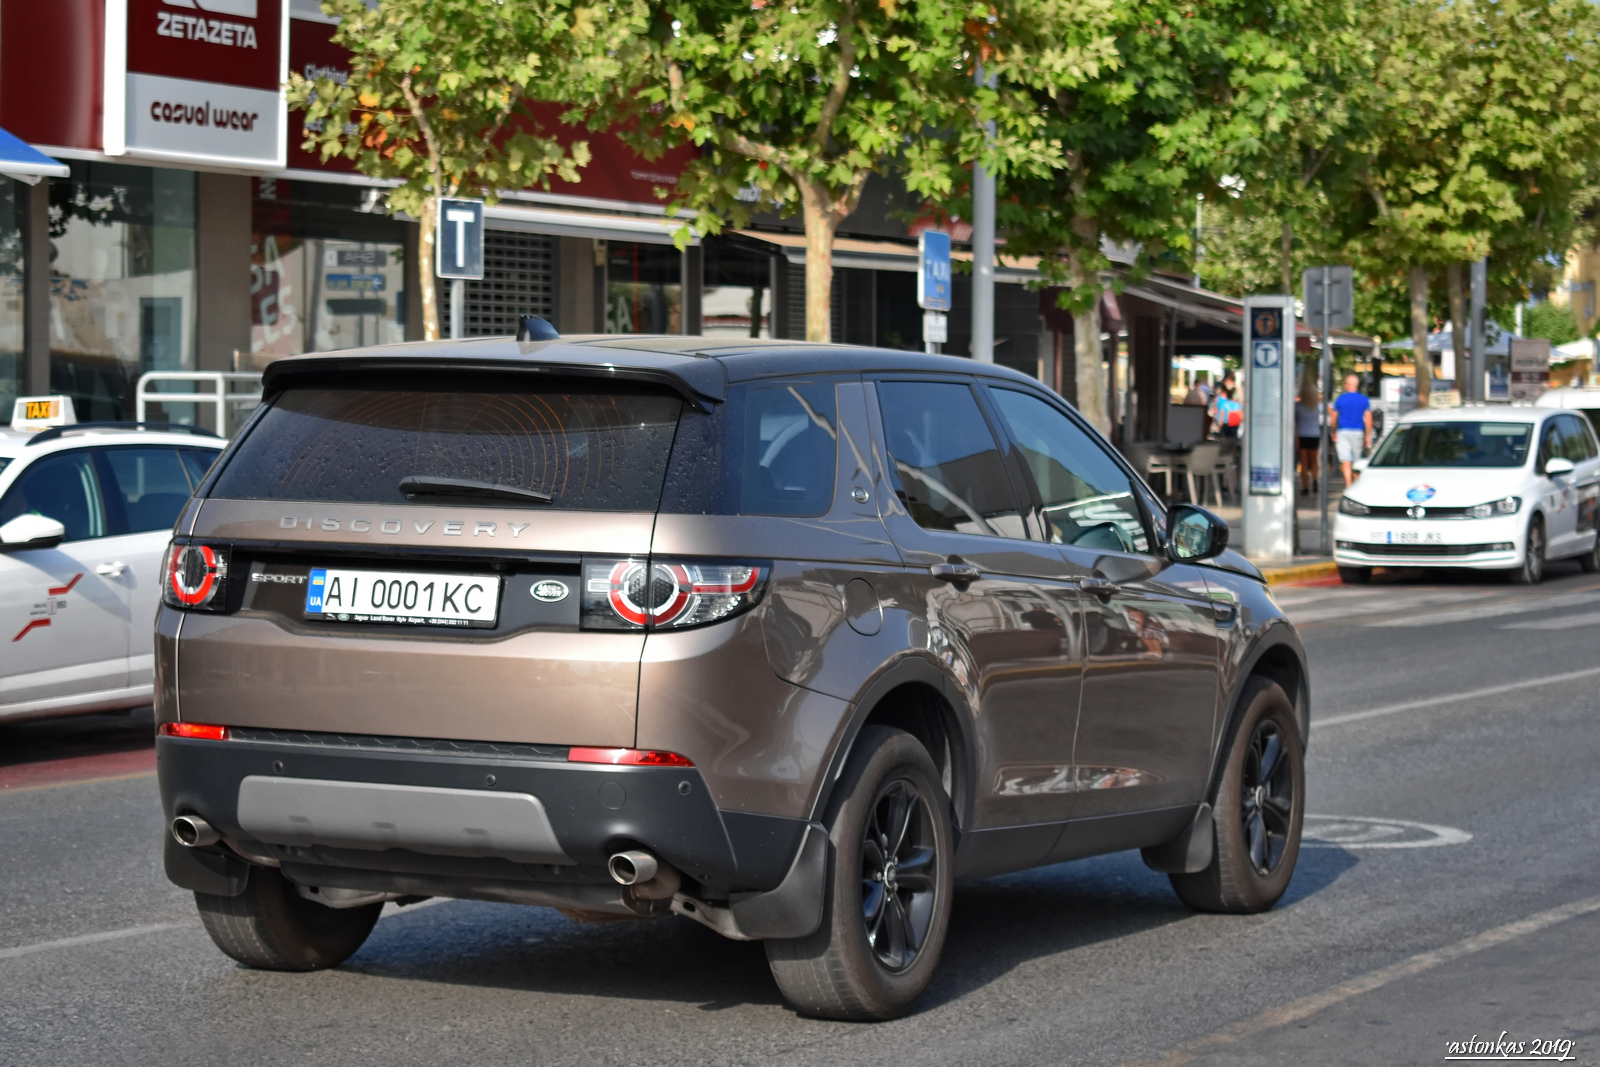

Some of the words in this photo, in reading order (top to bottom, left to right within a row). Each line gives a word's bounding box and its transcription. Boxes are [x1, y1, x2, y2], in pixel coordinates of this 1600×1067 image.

[157, 11, 258, 50] ZETAZETA
[151, 101, 210, 126] casual
[213, 108, 258, 132] wear
[26, 401, 51, 419] TAXI
[279, 514, 530, 539] DISCOVERY
[251, 572, 307, 584] SPORT
[310, 596, 322, 606] UA
